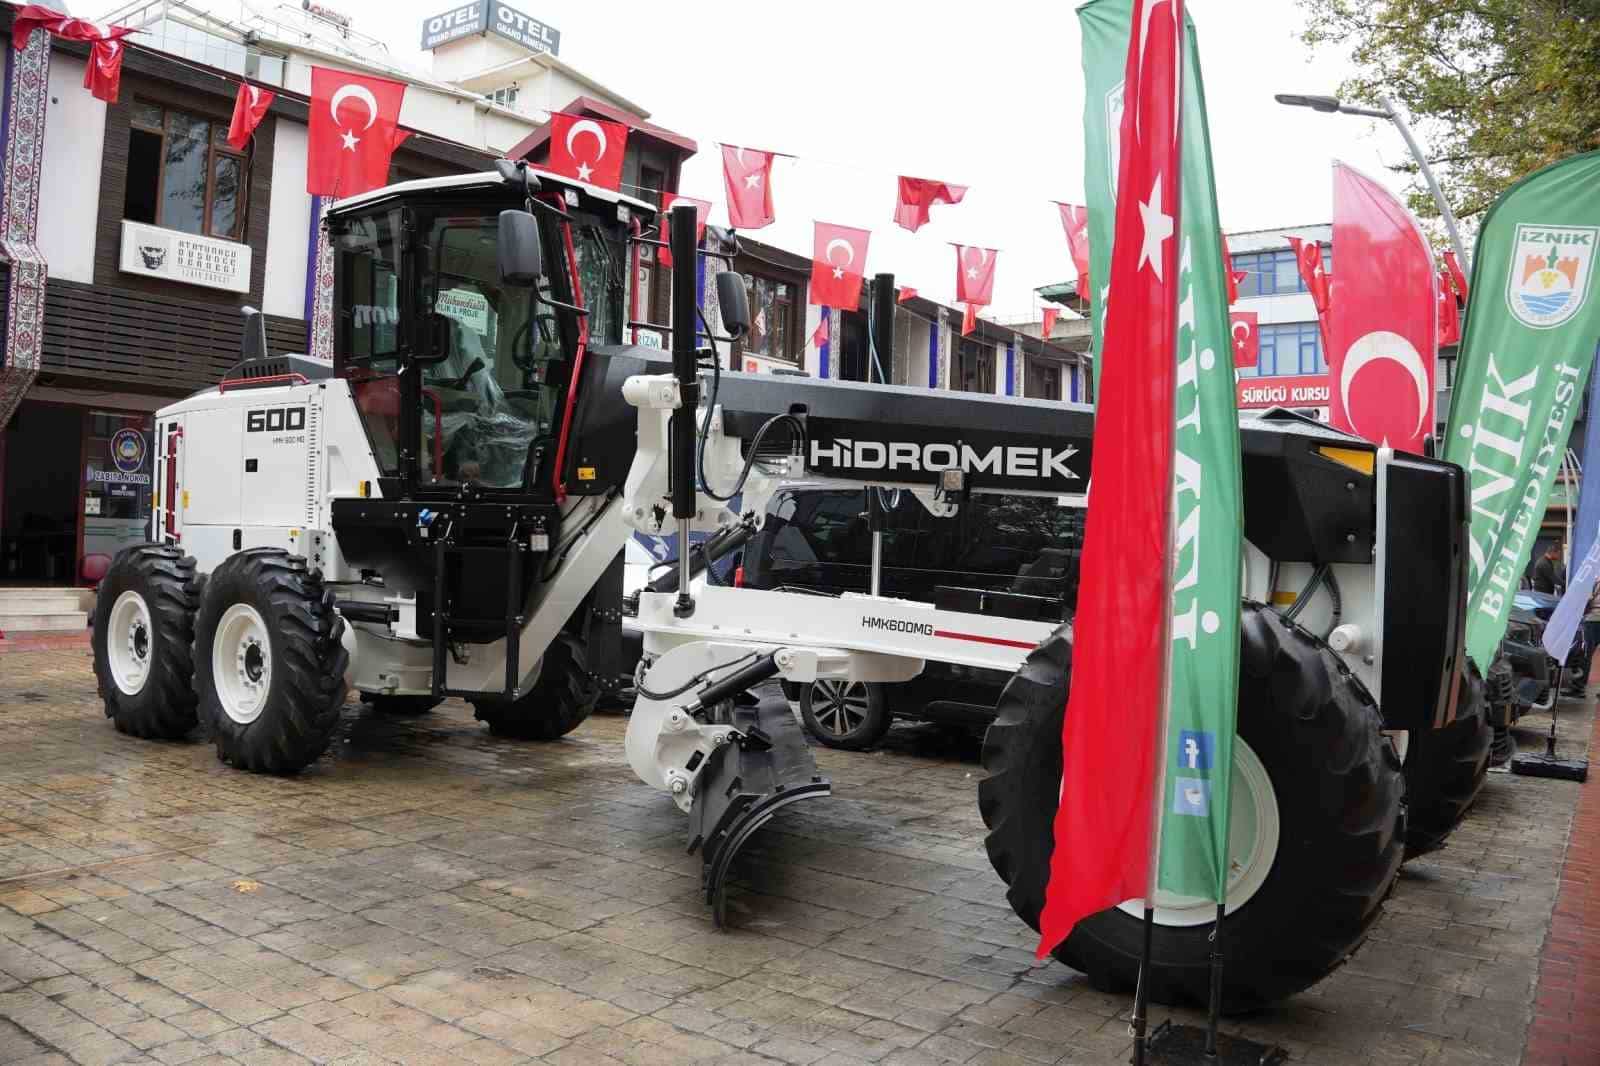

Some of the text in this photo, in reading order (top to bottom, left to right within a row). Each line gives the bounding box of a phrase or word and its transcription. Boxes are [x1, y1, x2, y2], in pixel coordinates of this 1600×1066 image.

[428, 6, 480, 33] OTEL
[498, 6, 553, 44] OTEL
[1241, 384, 1330, 403] SÜRÜCÜ KURSU
[246, 407, 305, 432] 600
[1460, 352, 1540, 603] ZNİK
[1478, 360, 1584, 622] BELEDİYESİ
[861, 616, 933, 636] HMK600MG
